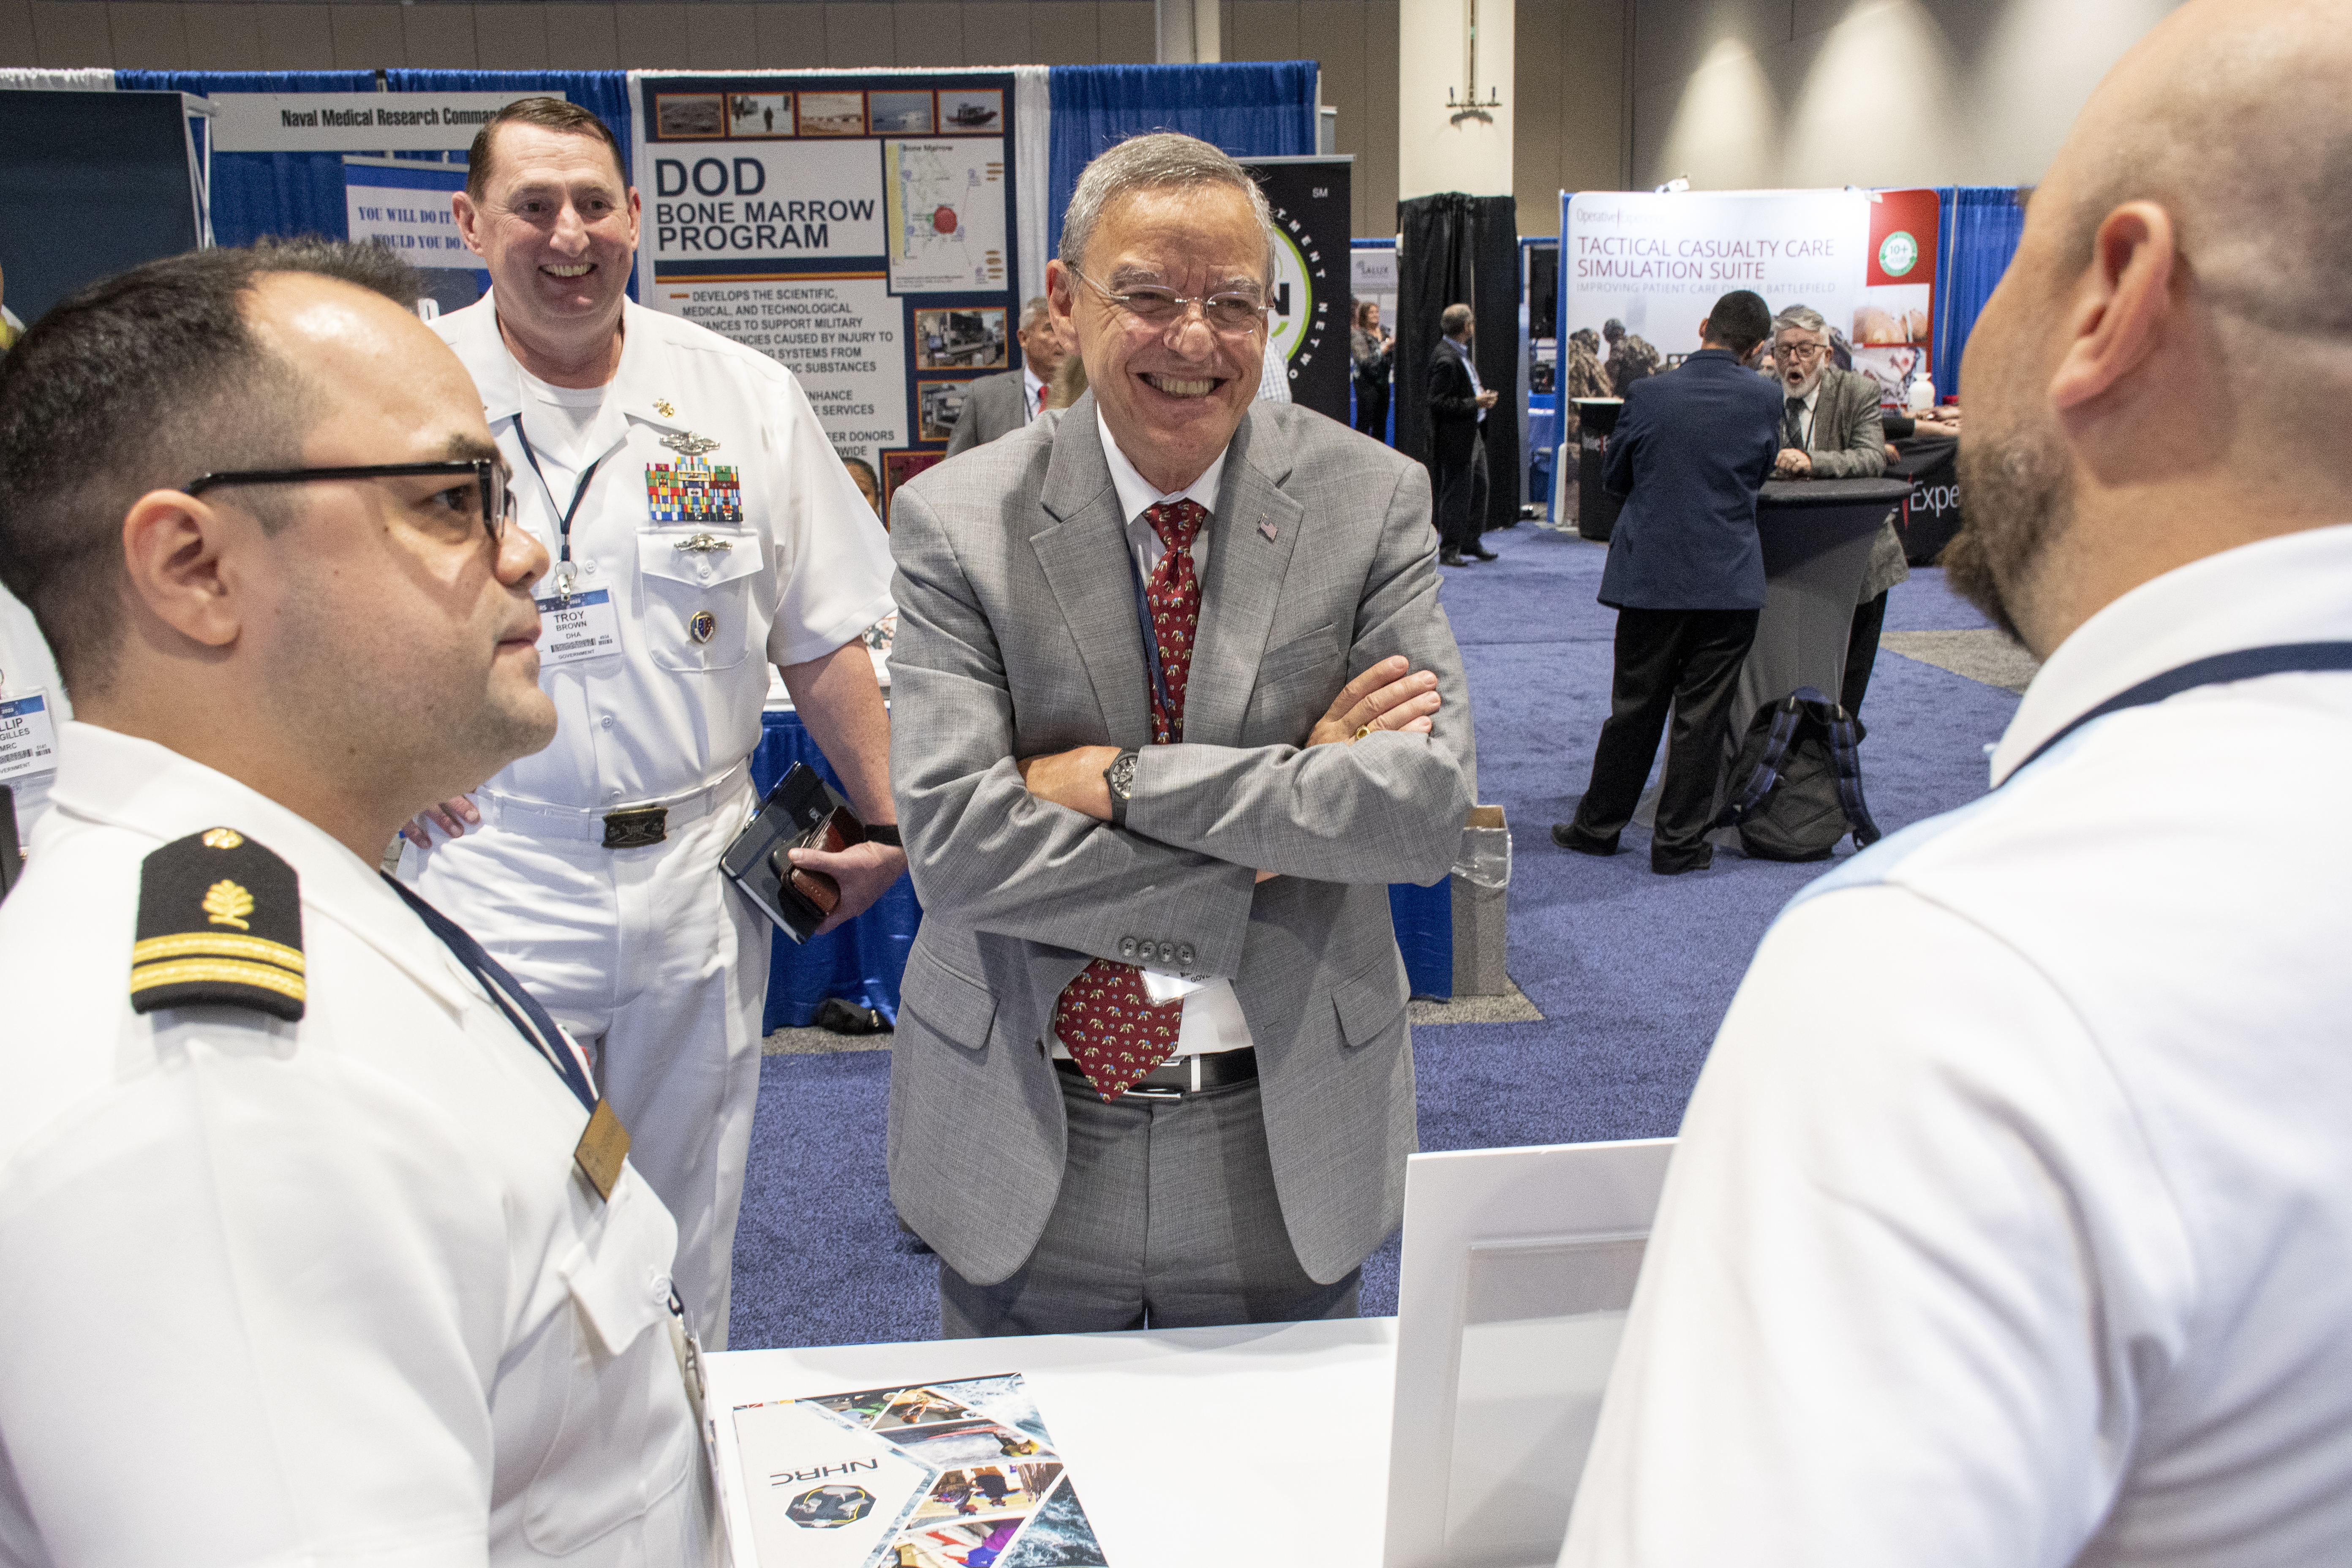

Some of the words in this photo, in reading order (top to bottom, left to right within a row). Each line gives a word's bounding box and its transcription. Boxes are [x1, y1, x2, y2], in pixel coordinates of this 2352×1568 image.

[282, 109, 318, 126] Naval
[322, 109, 373, 126] Medical
[377, 108, 438, 125] Research
[443, 107, 496, 125] Comman
[655, 157, 765, 197] DOD
[1312, 187, 1328, 199] SM
[359, 206, 382, 221] YOU
[387, 208, 417, 223] WILL
[420, 210, 436, 223] DO
[439, 210, 451, 224] IT
[656, 202, 735, 224] BONE
[745, 199, 874, 223] MARROW
[418, 235, 442, 249] YOU
[445, 236, 460, 250] DO
[658, 223, 829, 251] PROGRAM
[1577, 236, 1671, 256] TACTICAL
[1677, 239, 1780, 258] CASUALTY
[1786, 239, 1835, 257] CARE
[1577, 259, 1703, 279] SIMULATION
[1710, 261, 1765, 280] SUITE
[692, 290, 749, 302] DEVELOPS
[754, 289, 774, 301] THE
[776, 288, 838, 301] SCIENTIFIC,
[1576, 282, 1639, 294] IMPROVING
[1642, 283, 1685, 294] PATIENT
[1689, 283, 1717, 295] CARE
[1767, 282, 1836, 294] BATTLEFIELD
[682, 306, 733, 317] MEDICAL,
[735, 305, 758, 316] AND
[762, 302, 852, 315] TECHNOLOGICAL
[744, 319, 759, 330] TO
[761, 318, 811, 329] SUPPORT
[815, 317, 863, 329] MILITARY
[774, 333, 818, 344] CAUSED
[821, 332, 835, 343] BY
[838, 331, 875, 343] INJURY
[879, 331, 893, 342] TO
[778, 347, 828, 359] SYSTEMS
[831, 346, 861, 357] FROM
[805, 361, 877, 373] SUBSTANCES
[822, 403, 874, 416] SERVICES
[849, 430, 895, 442] DONORS
[554, 611, 584, 623] TROY
[556, 621, 587, 632] BROWN
[558, 649, 595, 660] GOVERNMENT
[770, 1458, 878, 1486] NHRC
